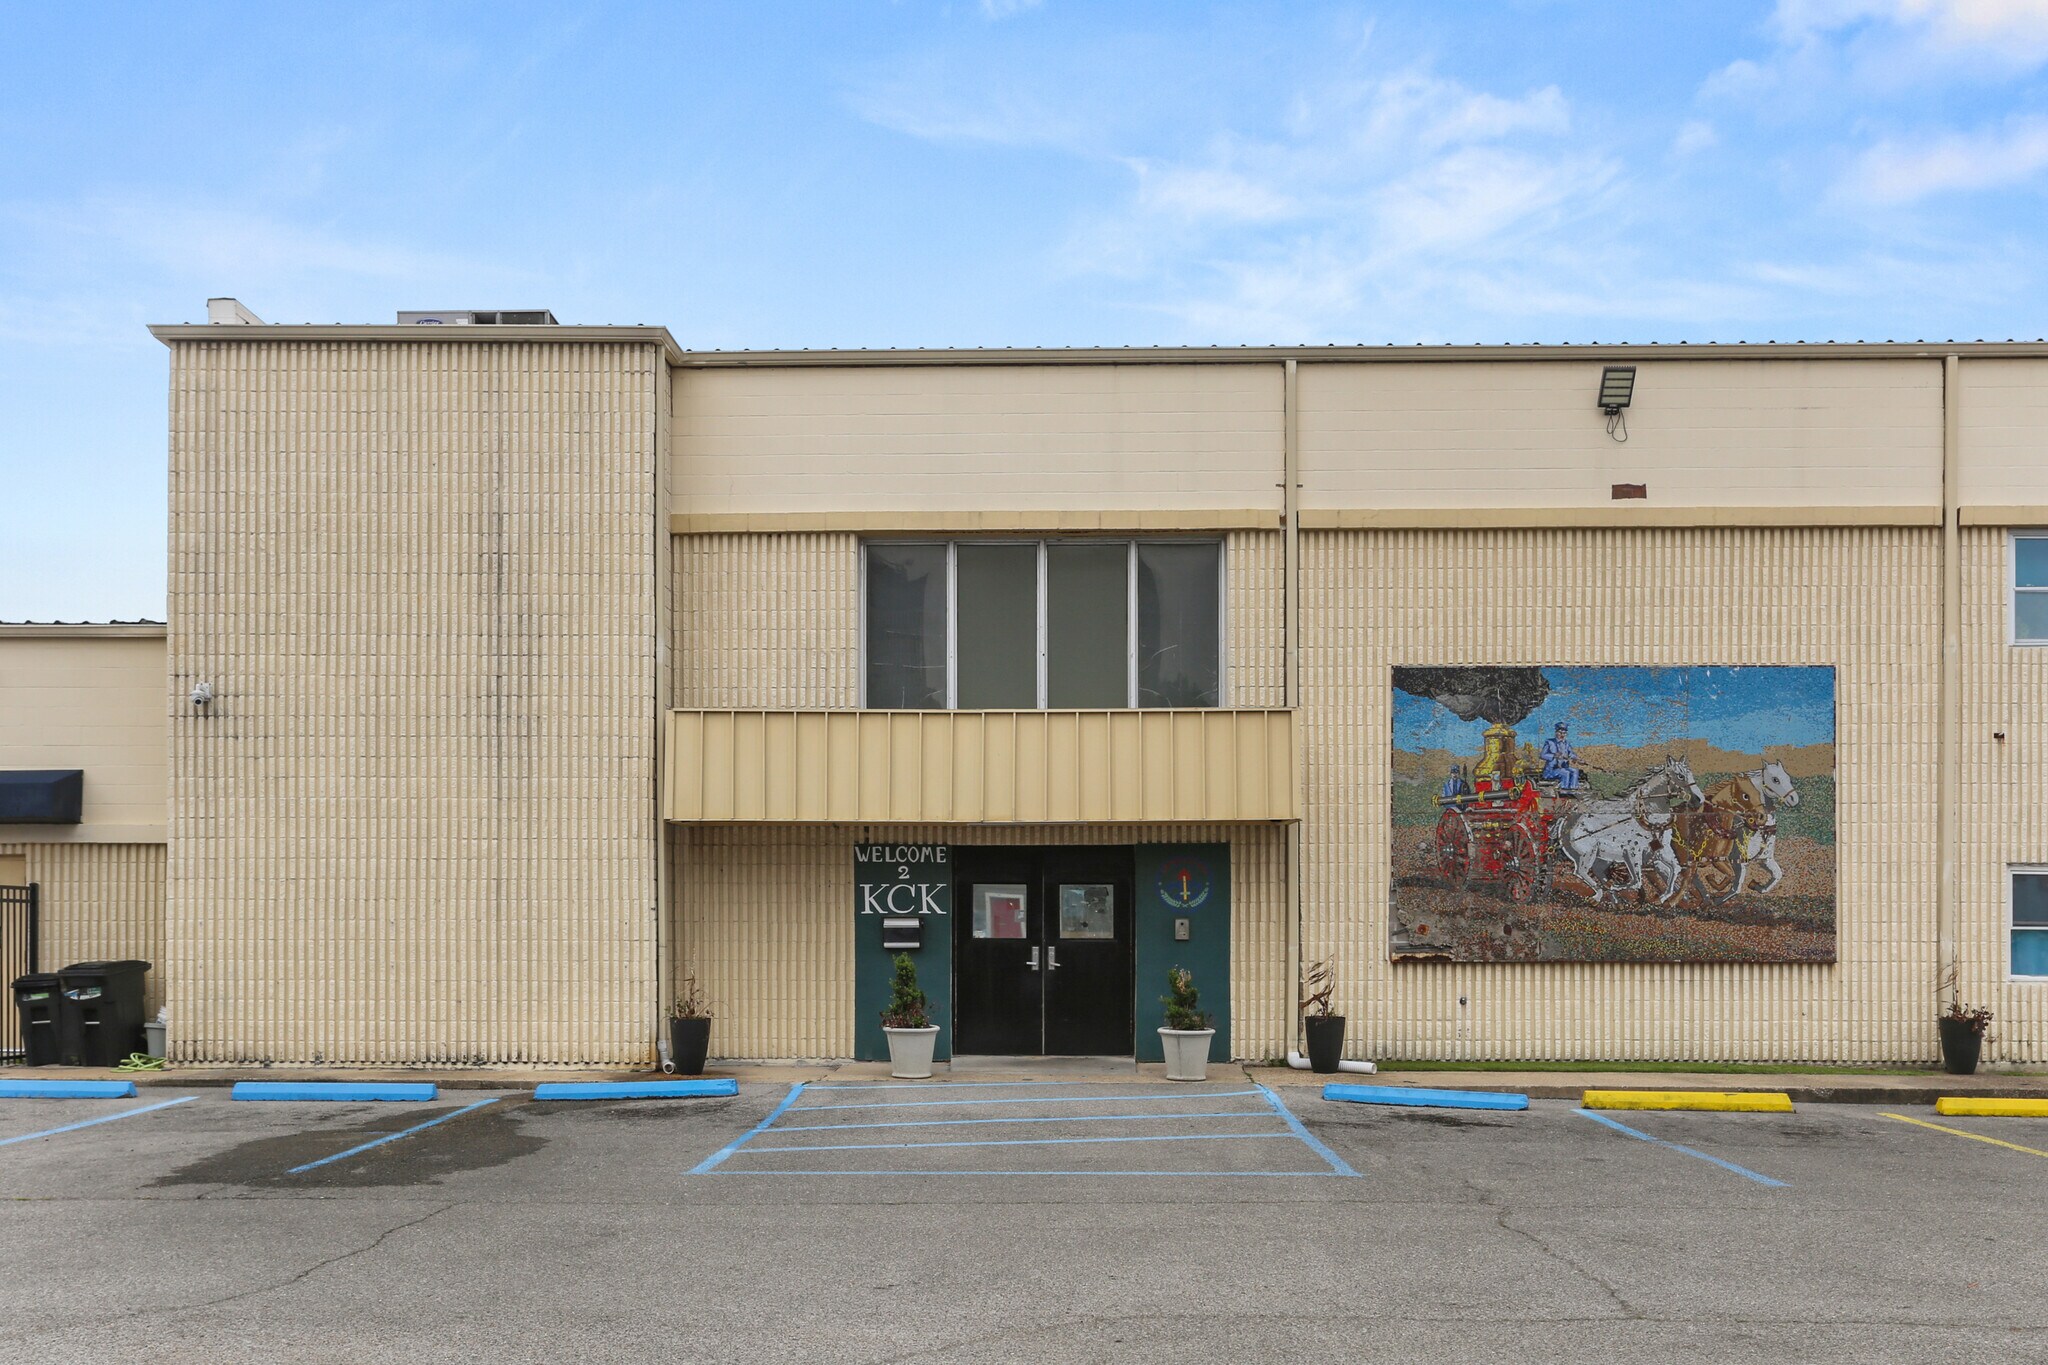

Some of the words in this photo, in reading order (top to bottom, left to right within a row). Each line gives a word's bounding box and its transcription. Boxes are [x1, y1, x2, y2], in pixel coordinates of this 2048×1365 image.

[854, 846, 947, 863] WELCOME
[898, 865, 910, 880] 2
[859, 883, 947, 914] KCK
